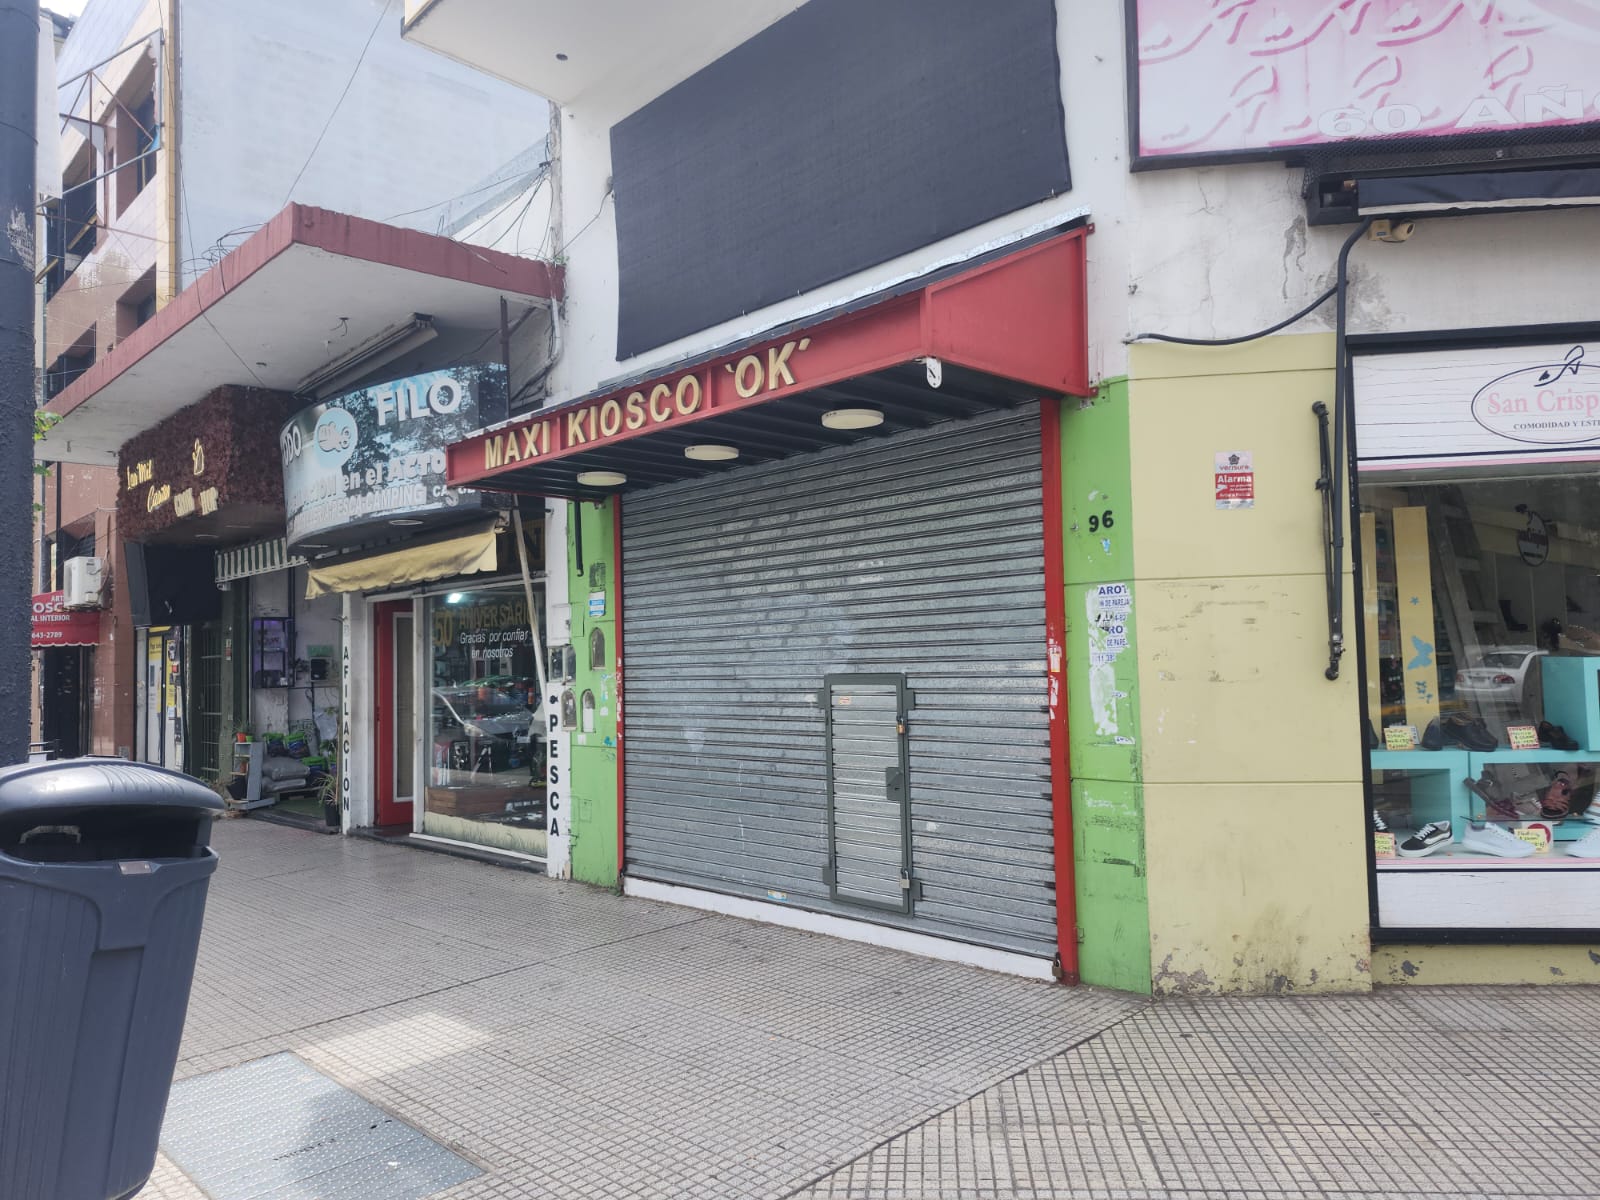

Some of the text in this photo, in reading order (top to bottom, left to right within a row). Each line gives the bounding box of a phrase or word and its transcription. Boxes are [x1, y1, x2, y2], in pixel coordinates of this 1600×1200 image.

[1318, 83, 1600, 137] 60 AÑ
[376, 376, 461, 426] FILO
[1487, 392, 1528, 415] San
[485, 420, 550, 470] MAXI
[567, 374, 702, 447] KIOSCO
[1513, 421, 1570, 431] COMODIDAD
[365, 462, 383, 487] el
[387, 449, 446, 482] ACTO
[1218, 474, 1252, 483] Alarma
[1089, 510, 1114, 532] 96
[40, 614, 70, 622] INTERIOR
[460, 627, 529, 645] Gracias por confiar
[482, 646, 514, 660] nosotros
[549, 714, 560, 837] PESCA
